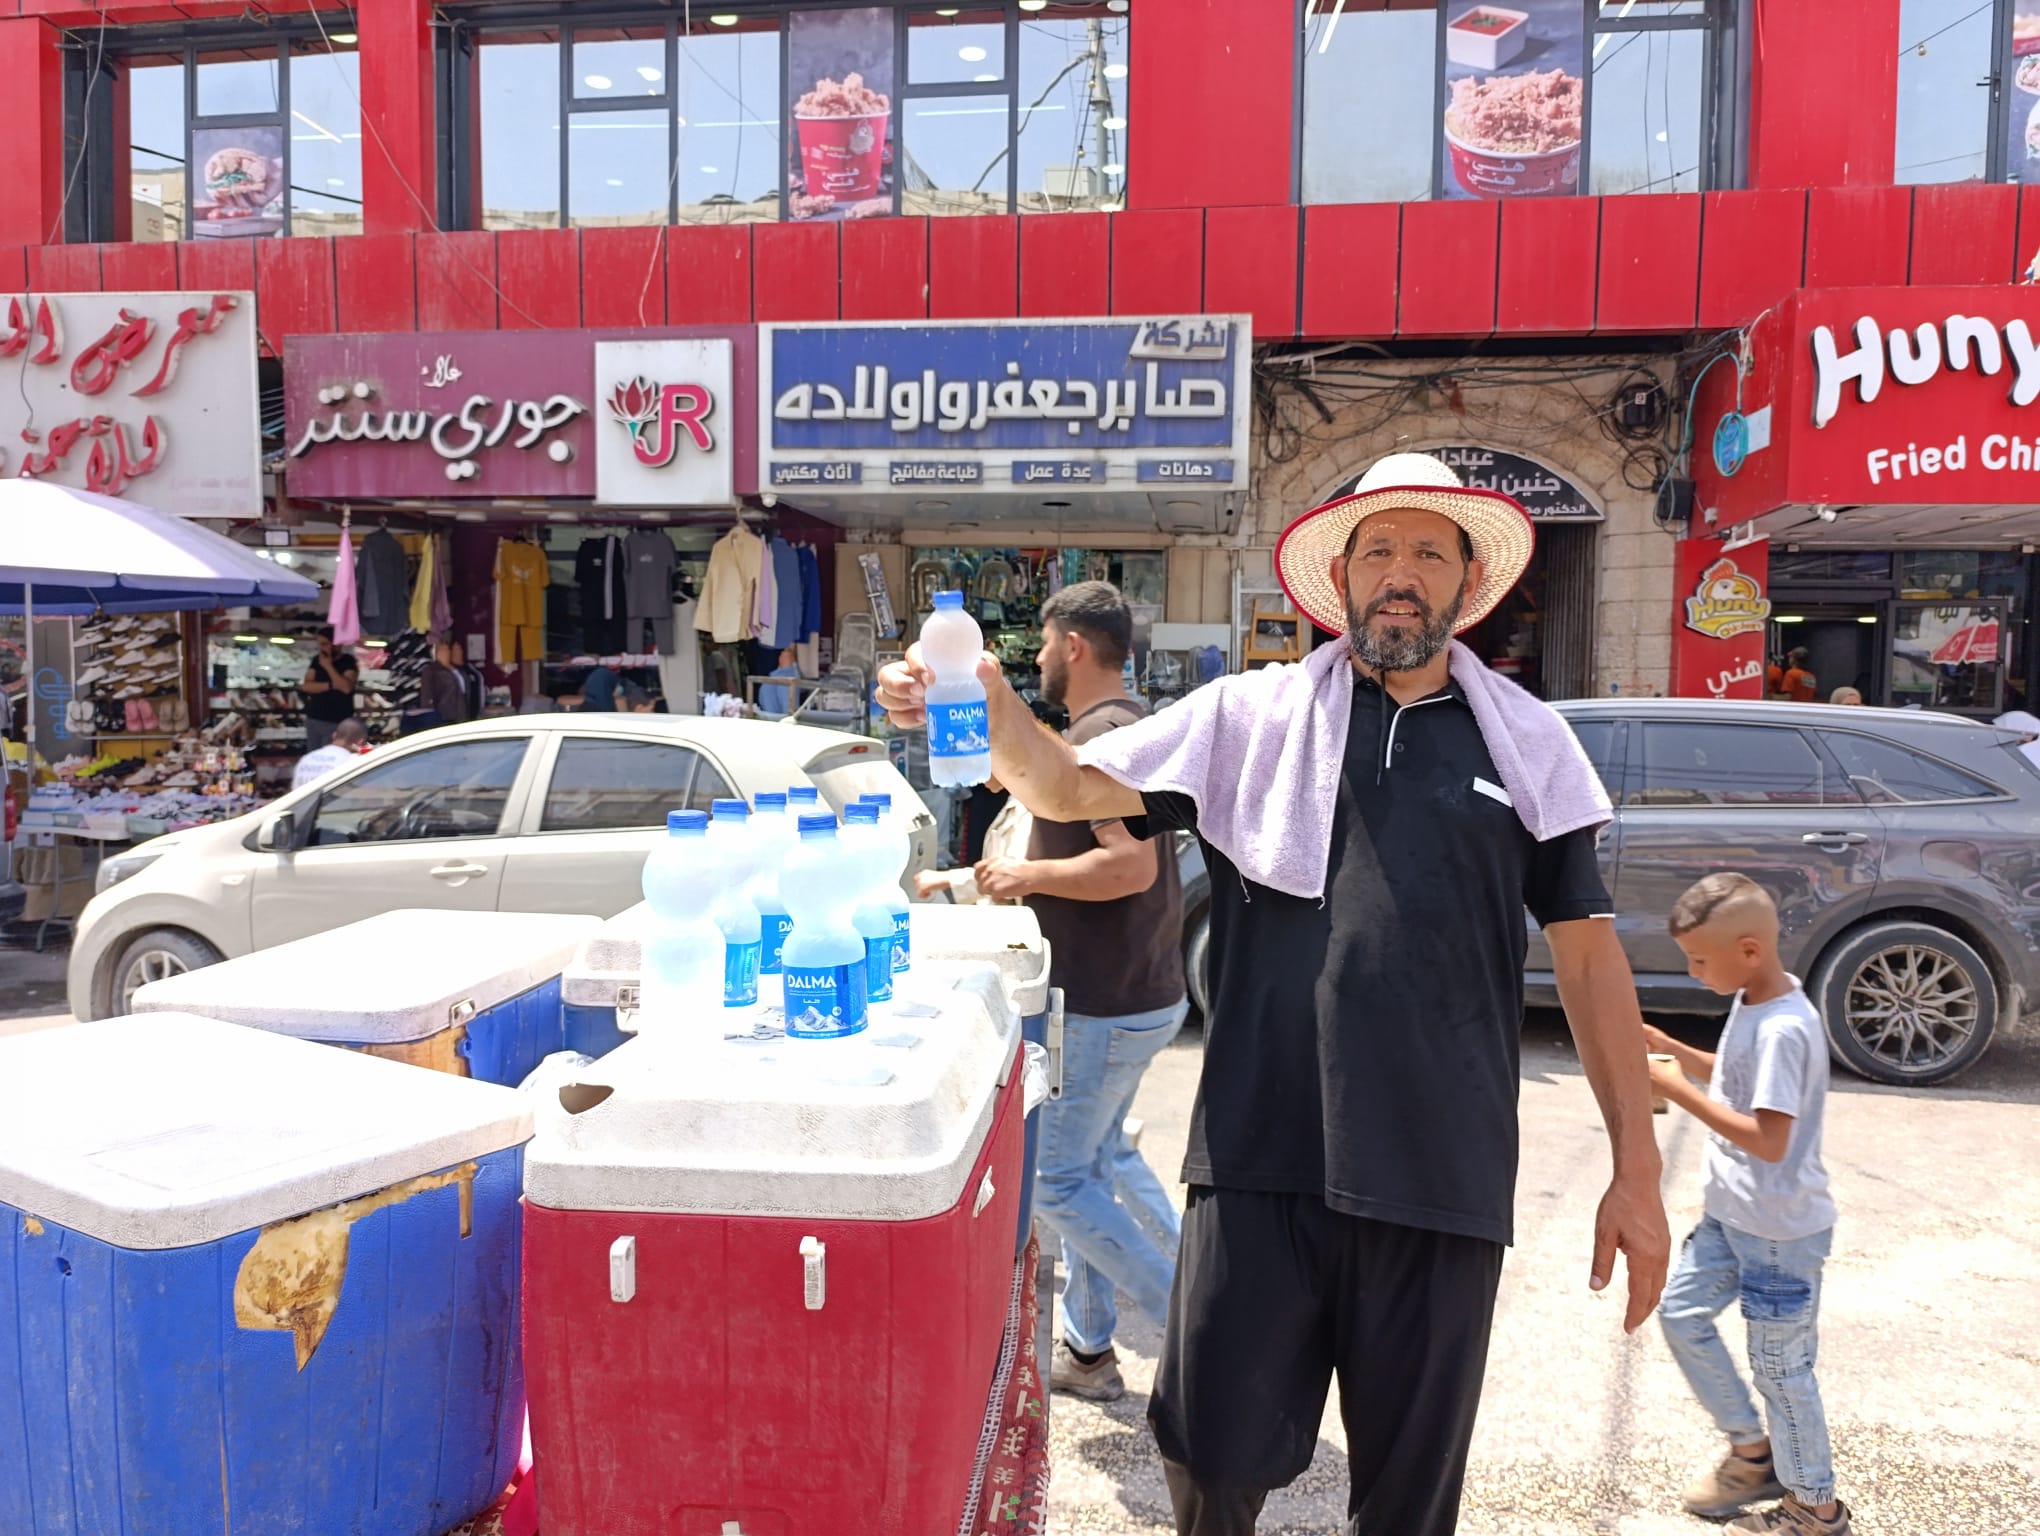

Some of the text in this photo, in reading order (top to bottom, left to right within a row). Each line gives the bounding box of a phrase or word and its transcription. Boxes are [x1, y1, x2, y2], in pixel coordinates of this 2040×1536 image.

[71, 294, 240, 396] معرض
[1143, 320, 1226, 353] شركة
[1812, 314, 2040, 429] Huny
[969, 362, 1097, 435] جعفر
[1098, 362, 1226, 431] صابر
[290, 381, 584, 481] جوري سنتر
[775, 465, 819, 484] مكتبي
[1024, 462, 1092, 481] عدة عمل
[1867, 434, 1967, 485] Fried
[1501, 471, 1562, 497] جنين
[1542, 501, 1587, 517] الدكتور
[1692, 597, 1767, 623] Huny
[1706, 656, 1762, 699] هني
[948, 705, 985, 721] DALMA
[787, 974, 837, 989] DALMA
